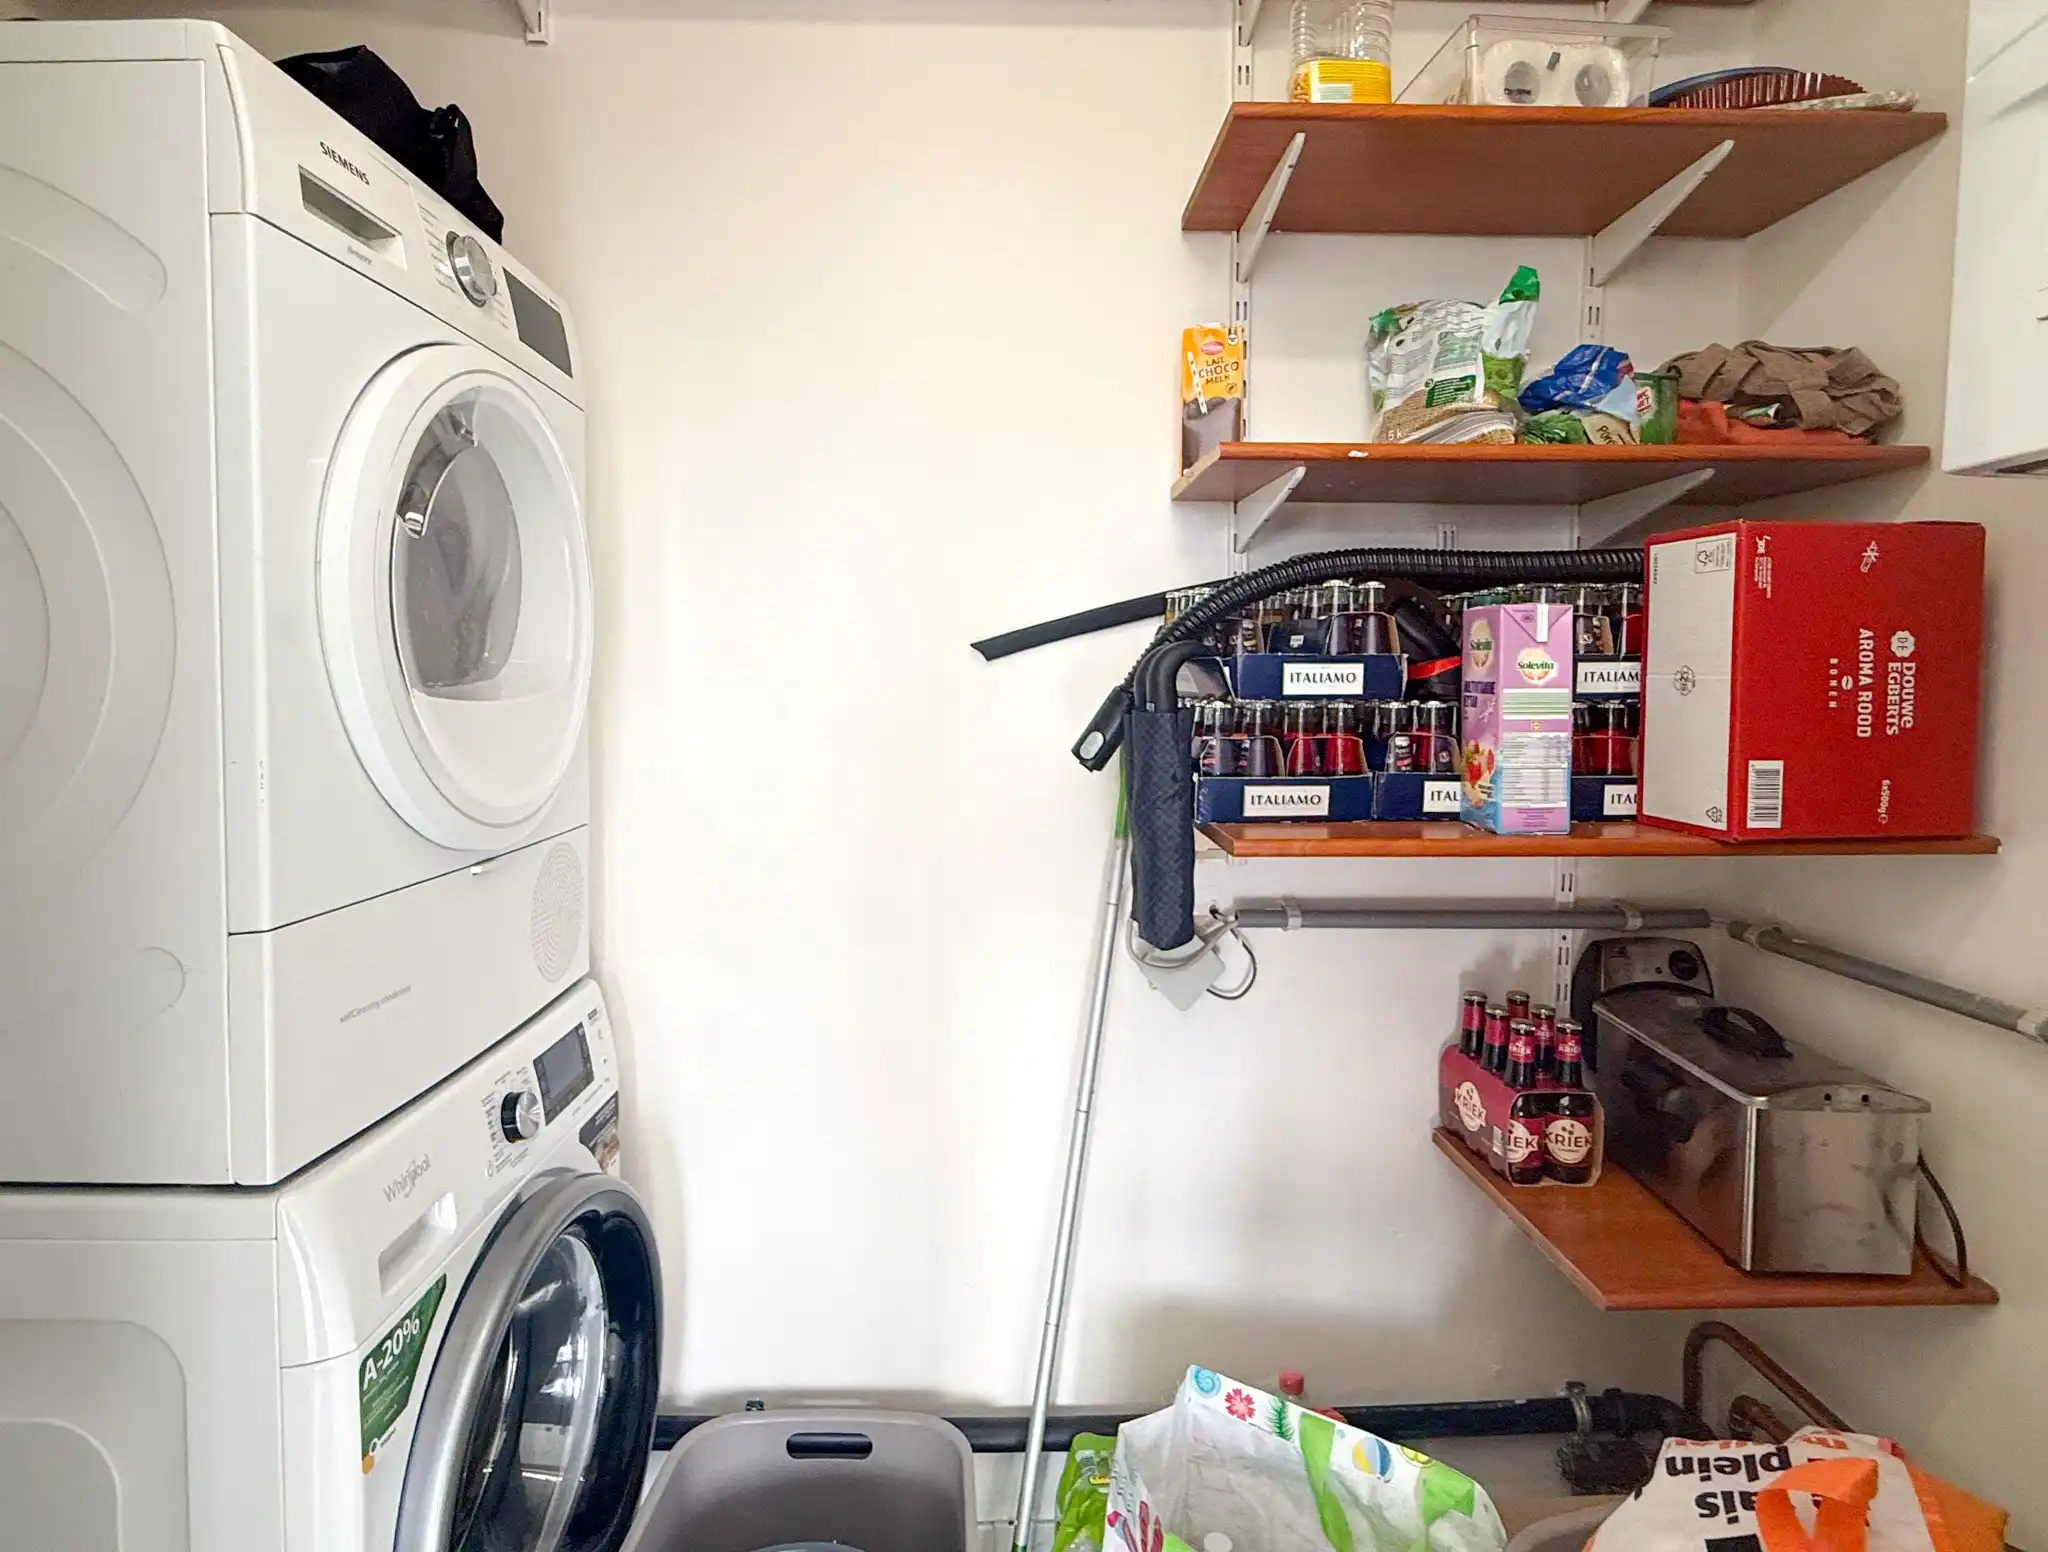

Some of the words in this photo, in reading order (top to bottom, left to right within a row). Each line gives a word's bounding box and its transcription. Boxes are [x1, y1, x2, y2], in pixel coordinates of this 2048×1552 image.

[319, 141, 370, 185] SIEMENS
[1198, 361, 1239, 378] CHOCO
[1517, 660, 1554, 671] Solevita
[1858, 627, 1875, 686] AROMA
[1289, 671, 1358, 685] ITALIAMO
[1583, 670, 1639, 684] ITALIAM
[1857, 691, 1873, 738] ROOD
[1886, 661, 1902, 736] EGBERTS
[1250, 794, 1322, 808] ITALIAMO
[1430, 790, 1459, 803] ITAL
[1507, 1134, 1536, 1149] IEK
[383, 1153, 432, 1202] Whirlpool
[363, 1312, 420, 1391] A-20%
[1665, 1445, 1792, 1483] plein
[1695, 1489, 1760, 1525] ais
